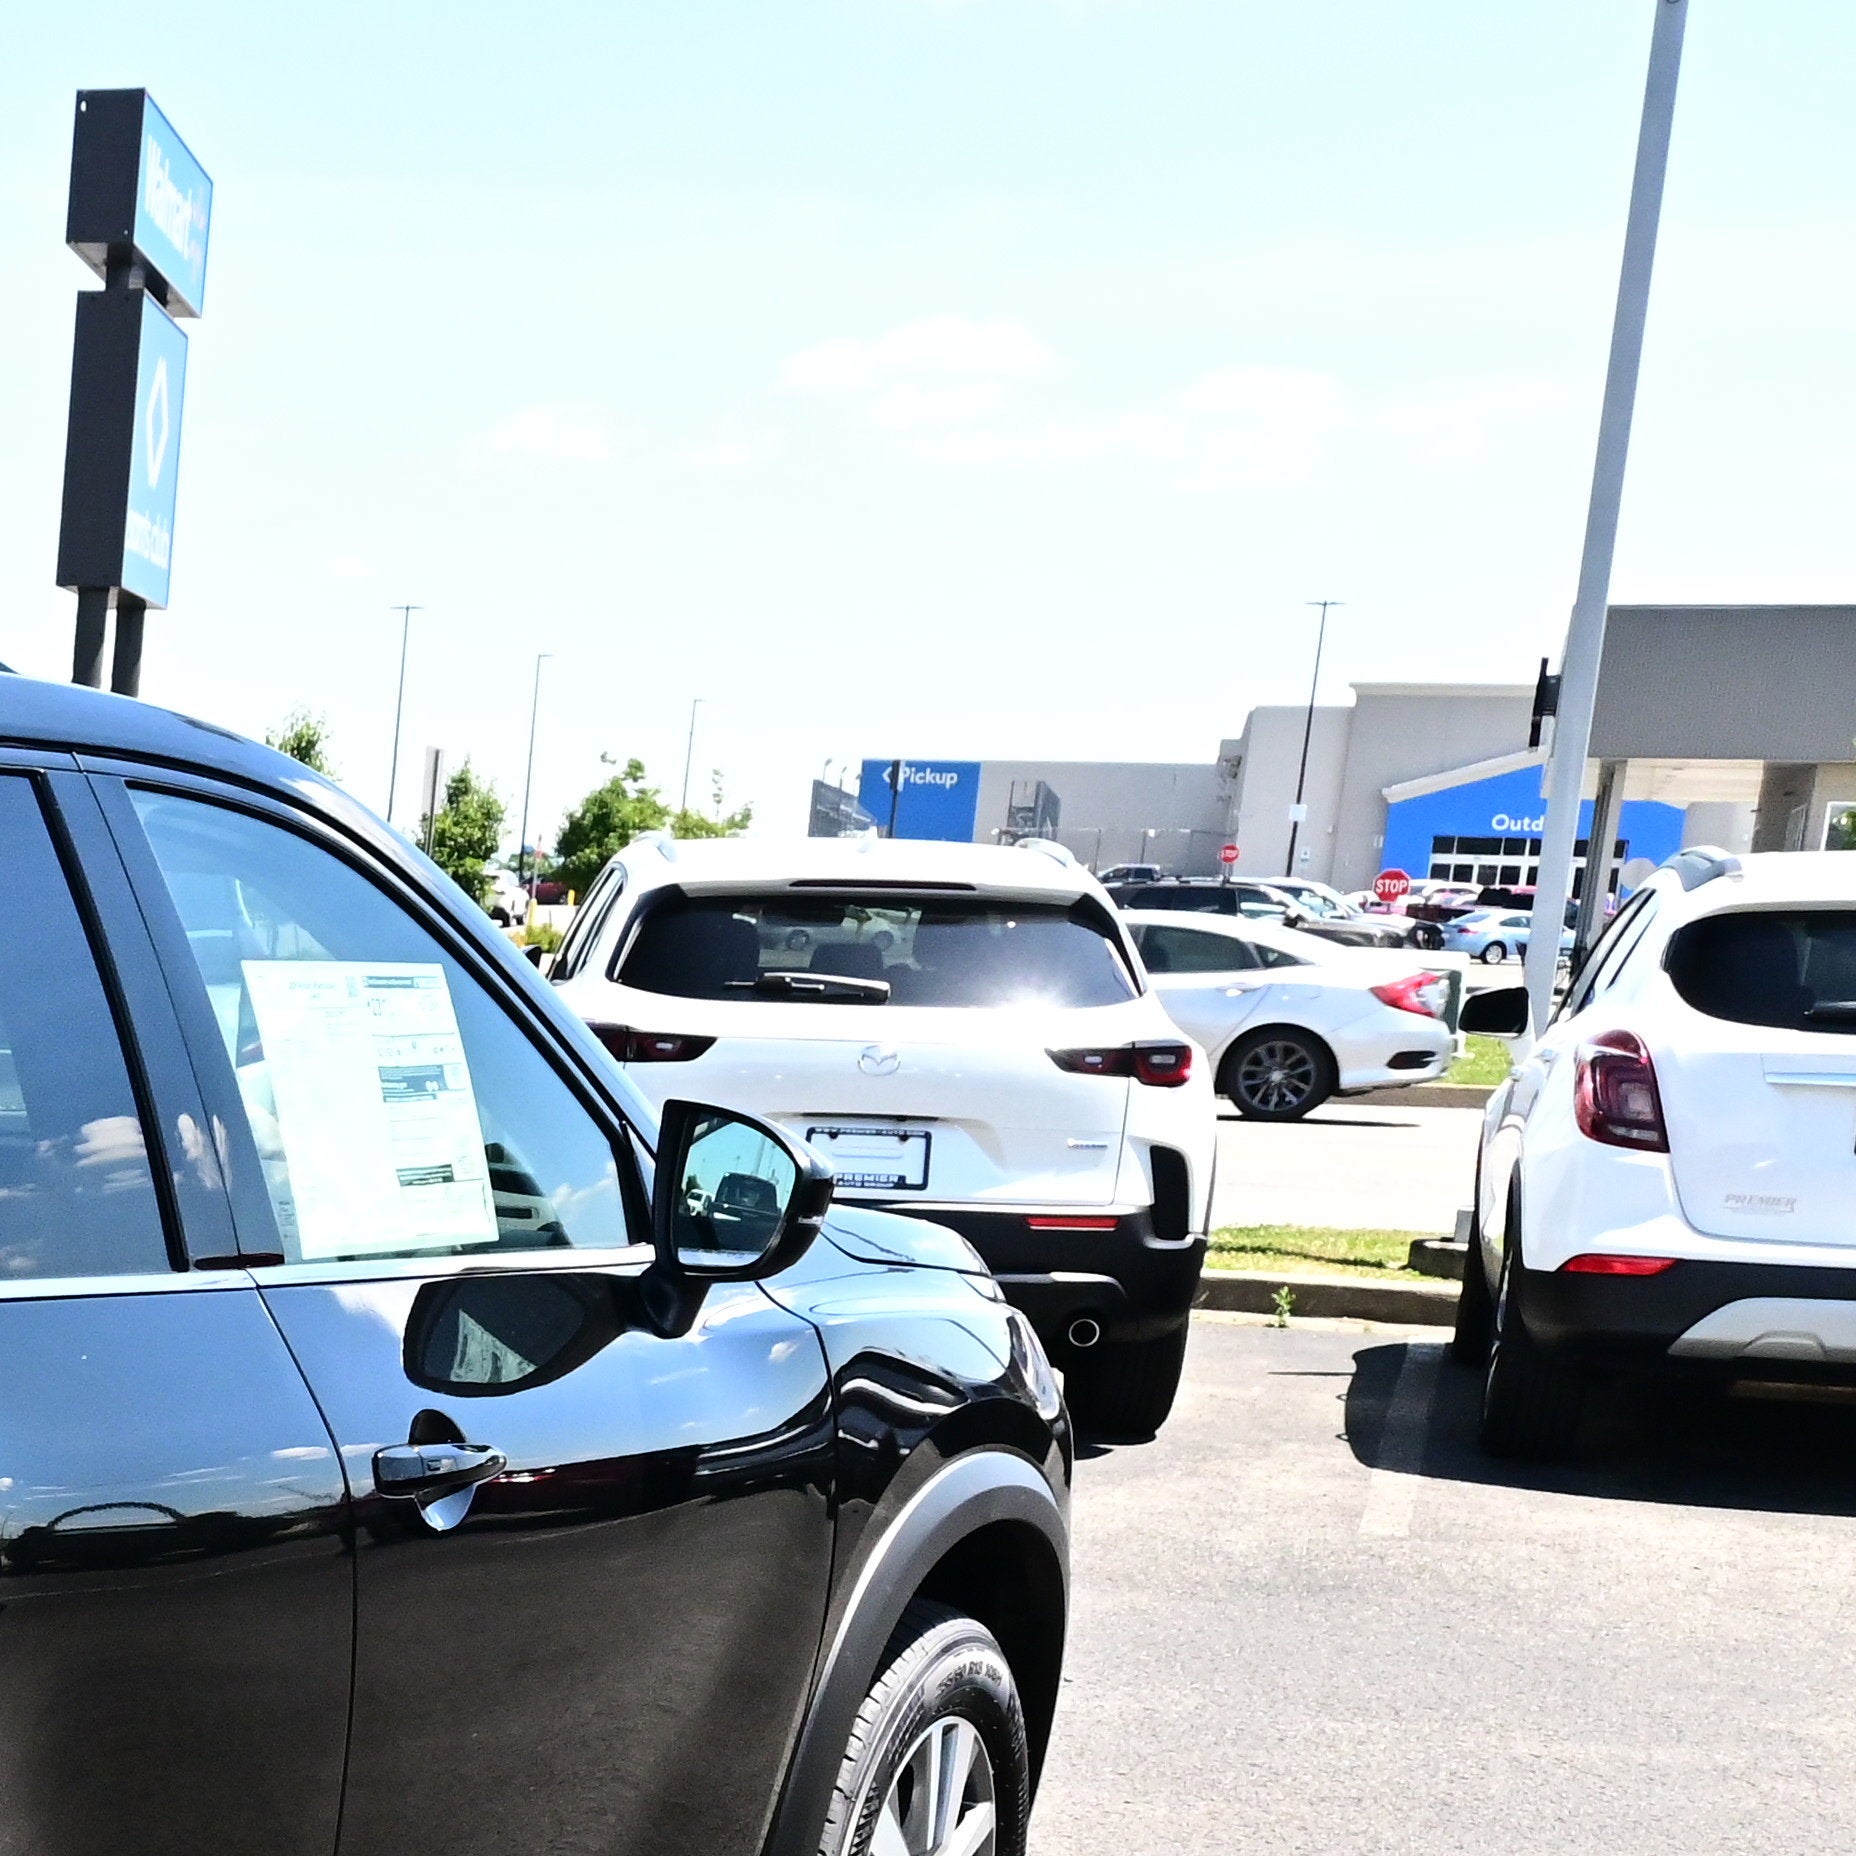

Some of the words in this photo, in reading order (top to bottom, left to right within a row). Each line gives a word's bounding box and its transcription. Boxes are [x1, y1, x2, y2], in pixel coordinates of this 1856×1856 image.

[898, 767, 958, 789] Pickup
[1491, 813, 1544, 832] Outd
[1375, 879, 1408, 893] STOP
